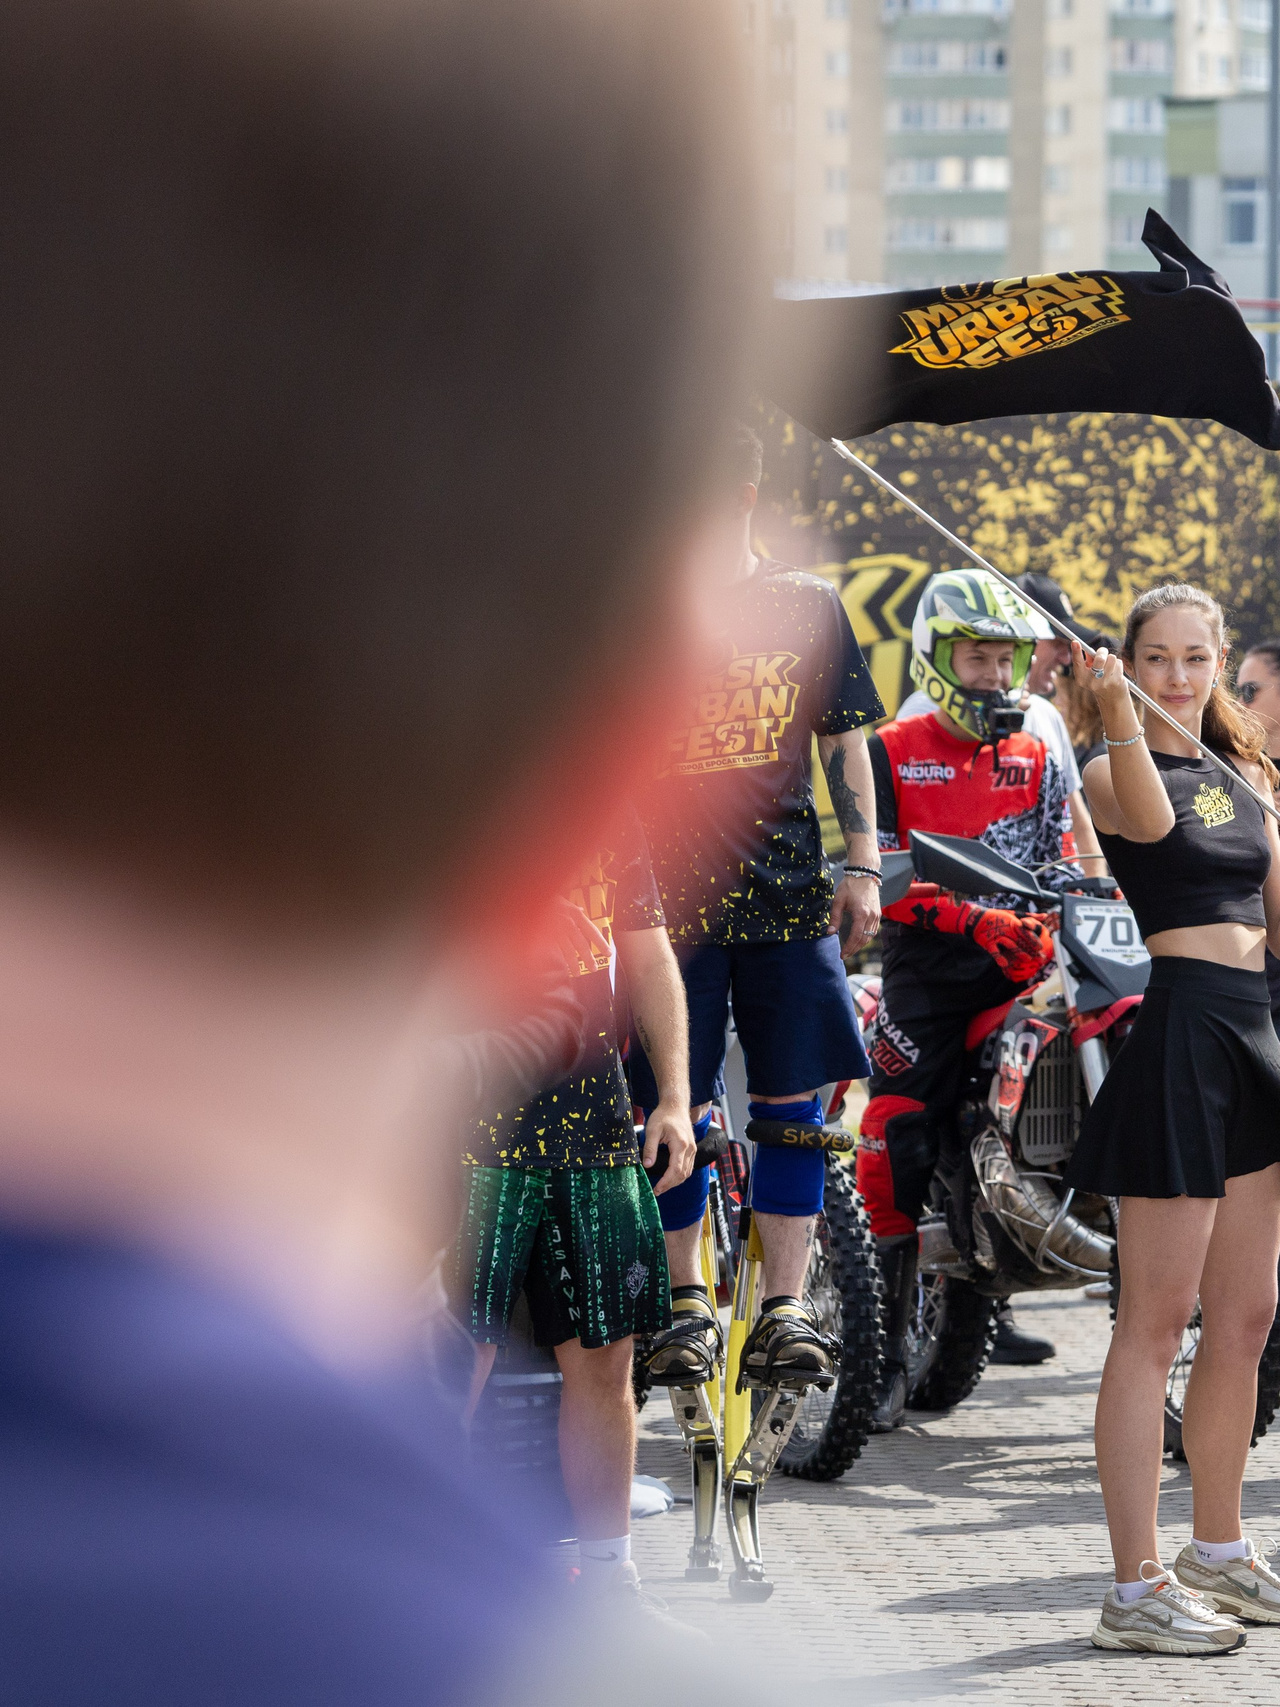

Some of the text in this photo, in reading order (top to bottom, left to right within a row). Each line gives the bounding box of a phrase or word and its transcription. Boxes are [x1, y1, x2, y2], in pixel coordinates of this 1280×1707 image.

[909, 277, 1106, 364] URBAN
[960, 294, 1103, 366] FEST
[705, 757, 741, 768] БРОСАЕТ
[742, 753, 770, 763] ВЫЗОВ
[1196, 795, 1231, 815] URBAN
[1204, 806, 1232, 824] FEST
[1083, 914, 1143, 948] 70
